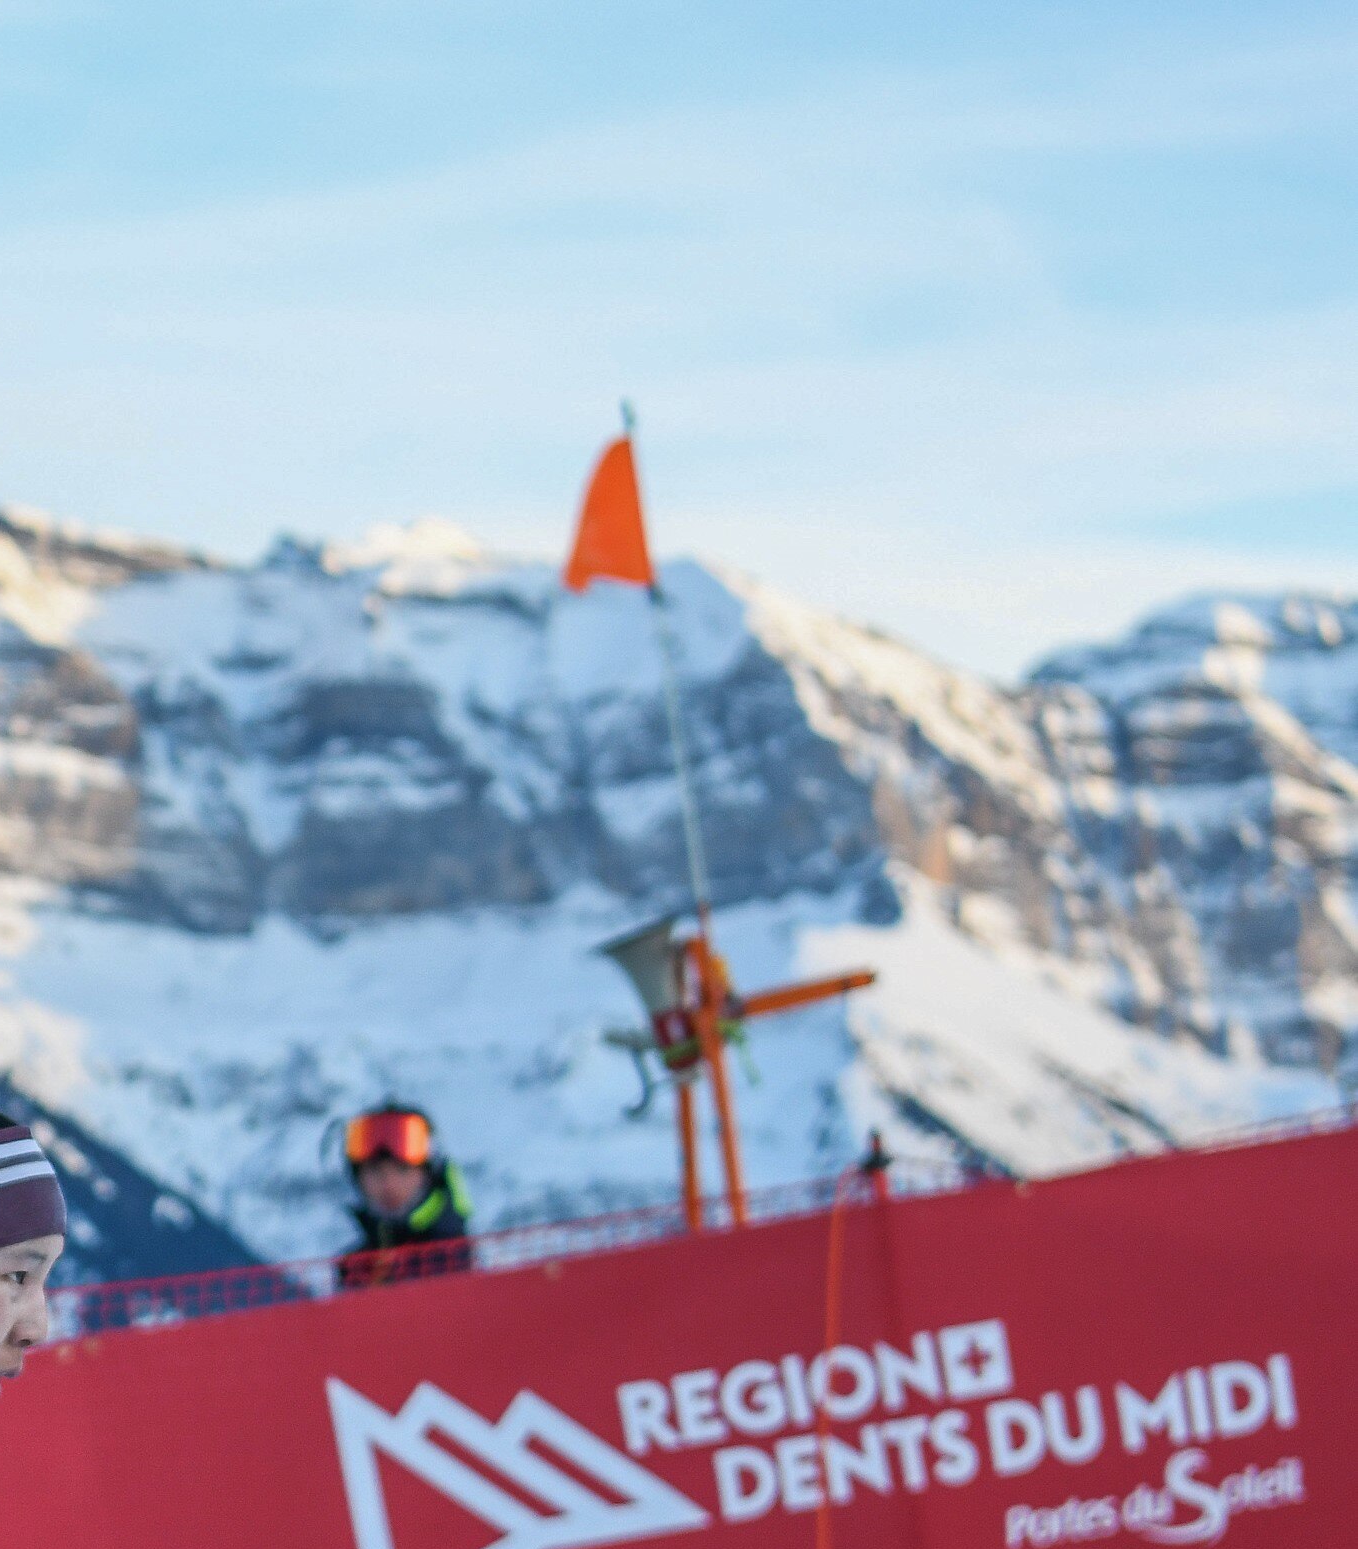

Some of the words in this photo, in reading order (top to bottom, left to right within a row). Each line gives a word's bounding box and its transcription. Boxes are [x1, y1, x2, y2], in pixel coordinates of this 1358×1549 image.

[617, 1331, 943, 1456] REGION
[713, 1410, 979, 1522] DENTS
[986, 1385, 1104, 1476] DU
[1114, 1354, 1297, 1454] MIDI
[1122, 1482, 1176, 1531] du
[1151, 1448, 1305, 1545] Soleil
